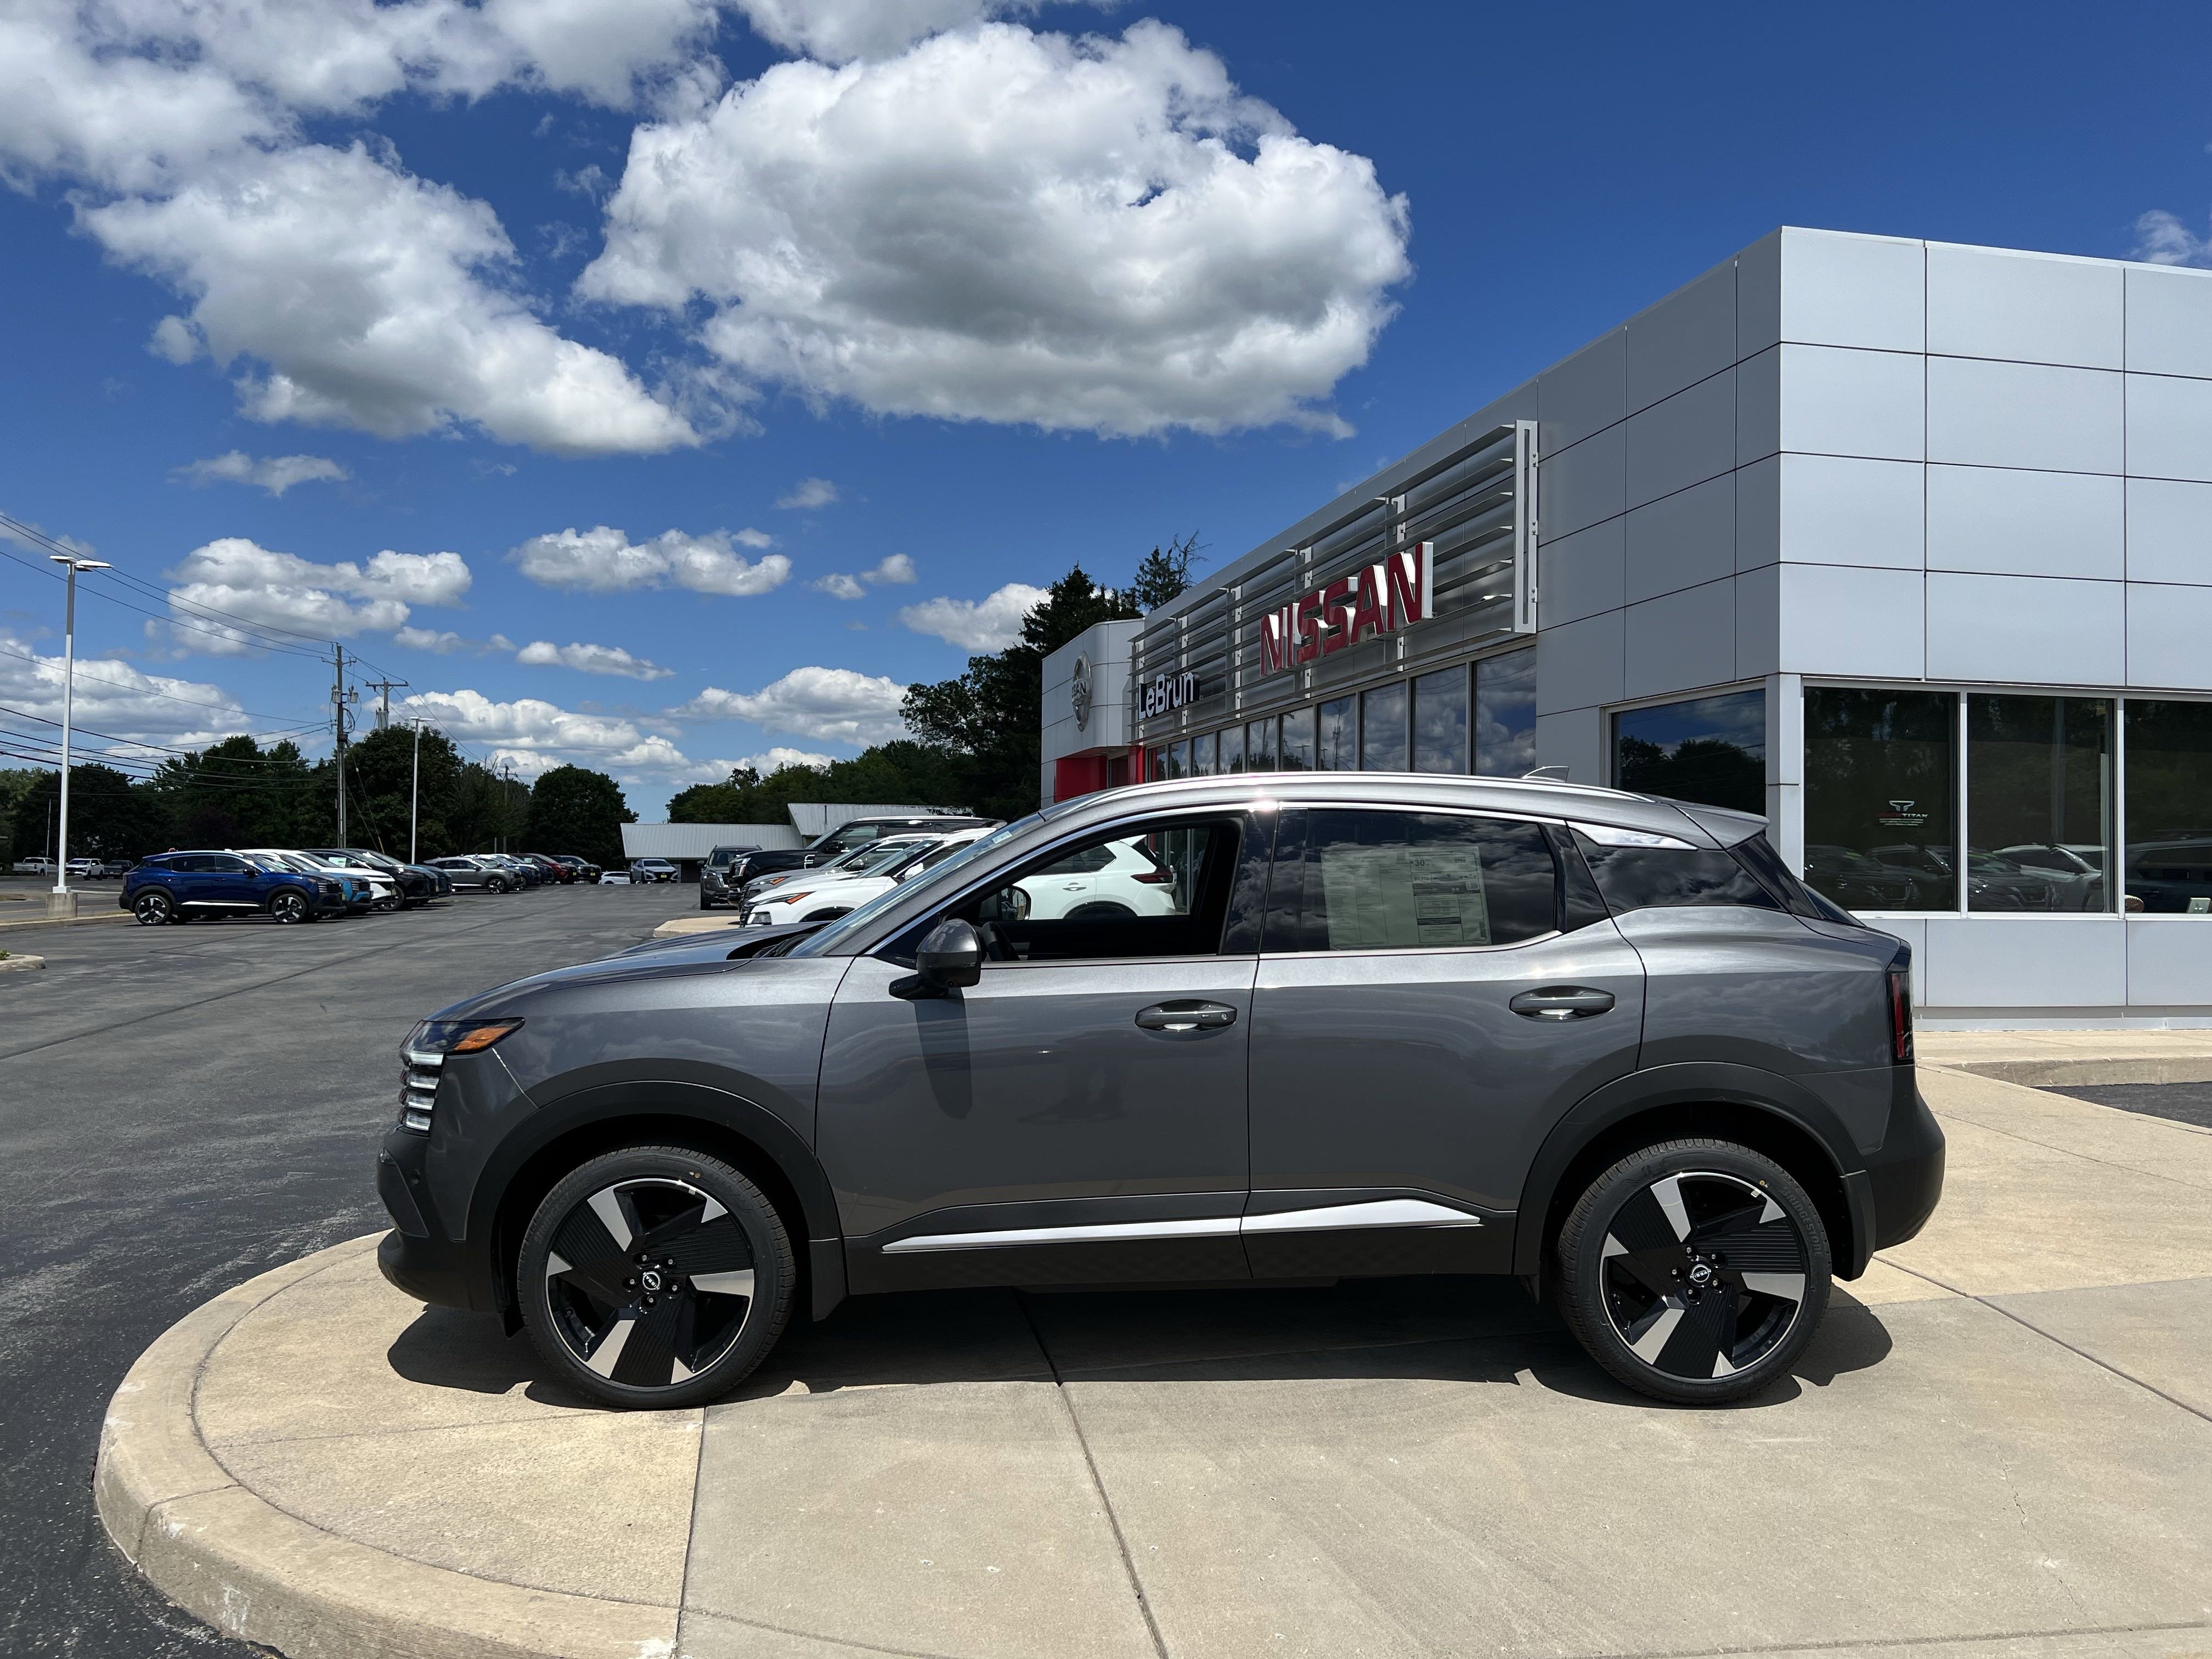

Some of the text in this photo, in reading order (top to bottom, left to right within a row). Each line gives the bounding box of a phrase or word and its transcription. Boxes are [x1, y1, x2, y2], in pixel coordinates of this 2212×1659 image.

[1260, 541, 1433, 676] NISSAN
[1138, 672, 1194, 720] LeBrun
[1781, 1186, 1822, 1258] BRIDGESTONE
[1690, 1268, 1711, 1279] NISSAN
